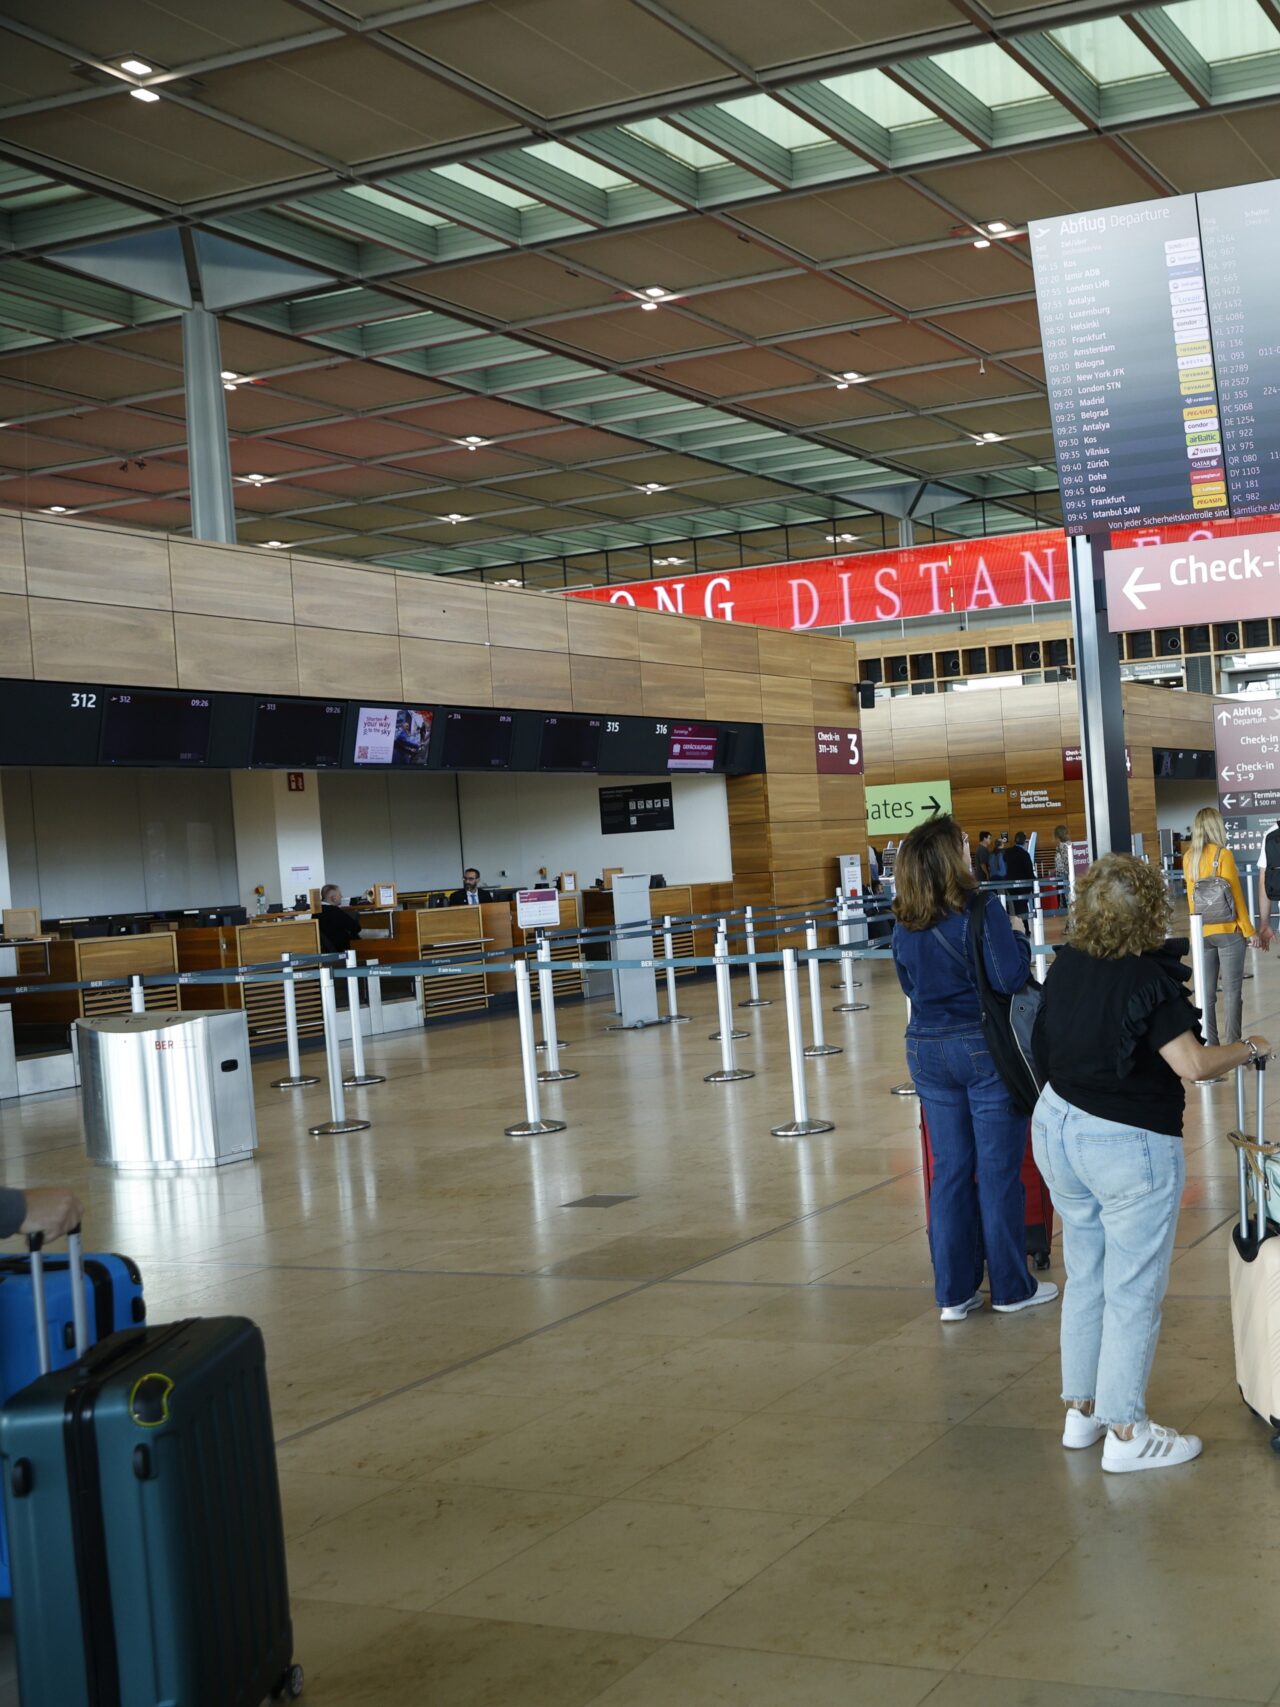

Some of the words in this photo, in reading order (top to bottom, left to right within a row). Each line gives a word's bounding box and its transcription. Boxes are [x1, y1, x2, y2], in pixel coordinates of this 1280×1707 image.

[1060, 215, 1106, 235] Abflug
[1110, 208, 1169, 228] Departure
[1093, 369, 1111, 378] York
[1112, 367, 1124, 376] JFK
[1080, 408, 1108, 419] Belgrad
[1084, 446, 1110, 456] Vilnius
[1088, 472, 1107, 481] Doha
[1092, 507, 1122, 518] Istanbul
[1123, 506, 1140, 514] SAW
[1123, 518, 1141, 529] jeder
[1142, 510, 1212, 525] Sicherheitskontrolle
[1214, 508, 1229, 517] sind
[1233, 504, 1267, 515] sämtliche
[70, 692, 96, 708] 312
[1233, 706, 1262, 717] Abflug
[1233, 716, 1267, 726] Departure
[606, 722, 619, 732] 315
[656, 724, 667, 734] 316
[1241, 734, 1279, 745] Check-in
[818, 732, 840, 742] Check-in
[848, 734, 859, 766] 3
[1236, 762, 1274, 772] Check-in
[1020, 789, 1048, 797] Lufthansa
[866, 798, 914, 820] ates
[155, 1040, 174, 1050] BER
